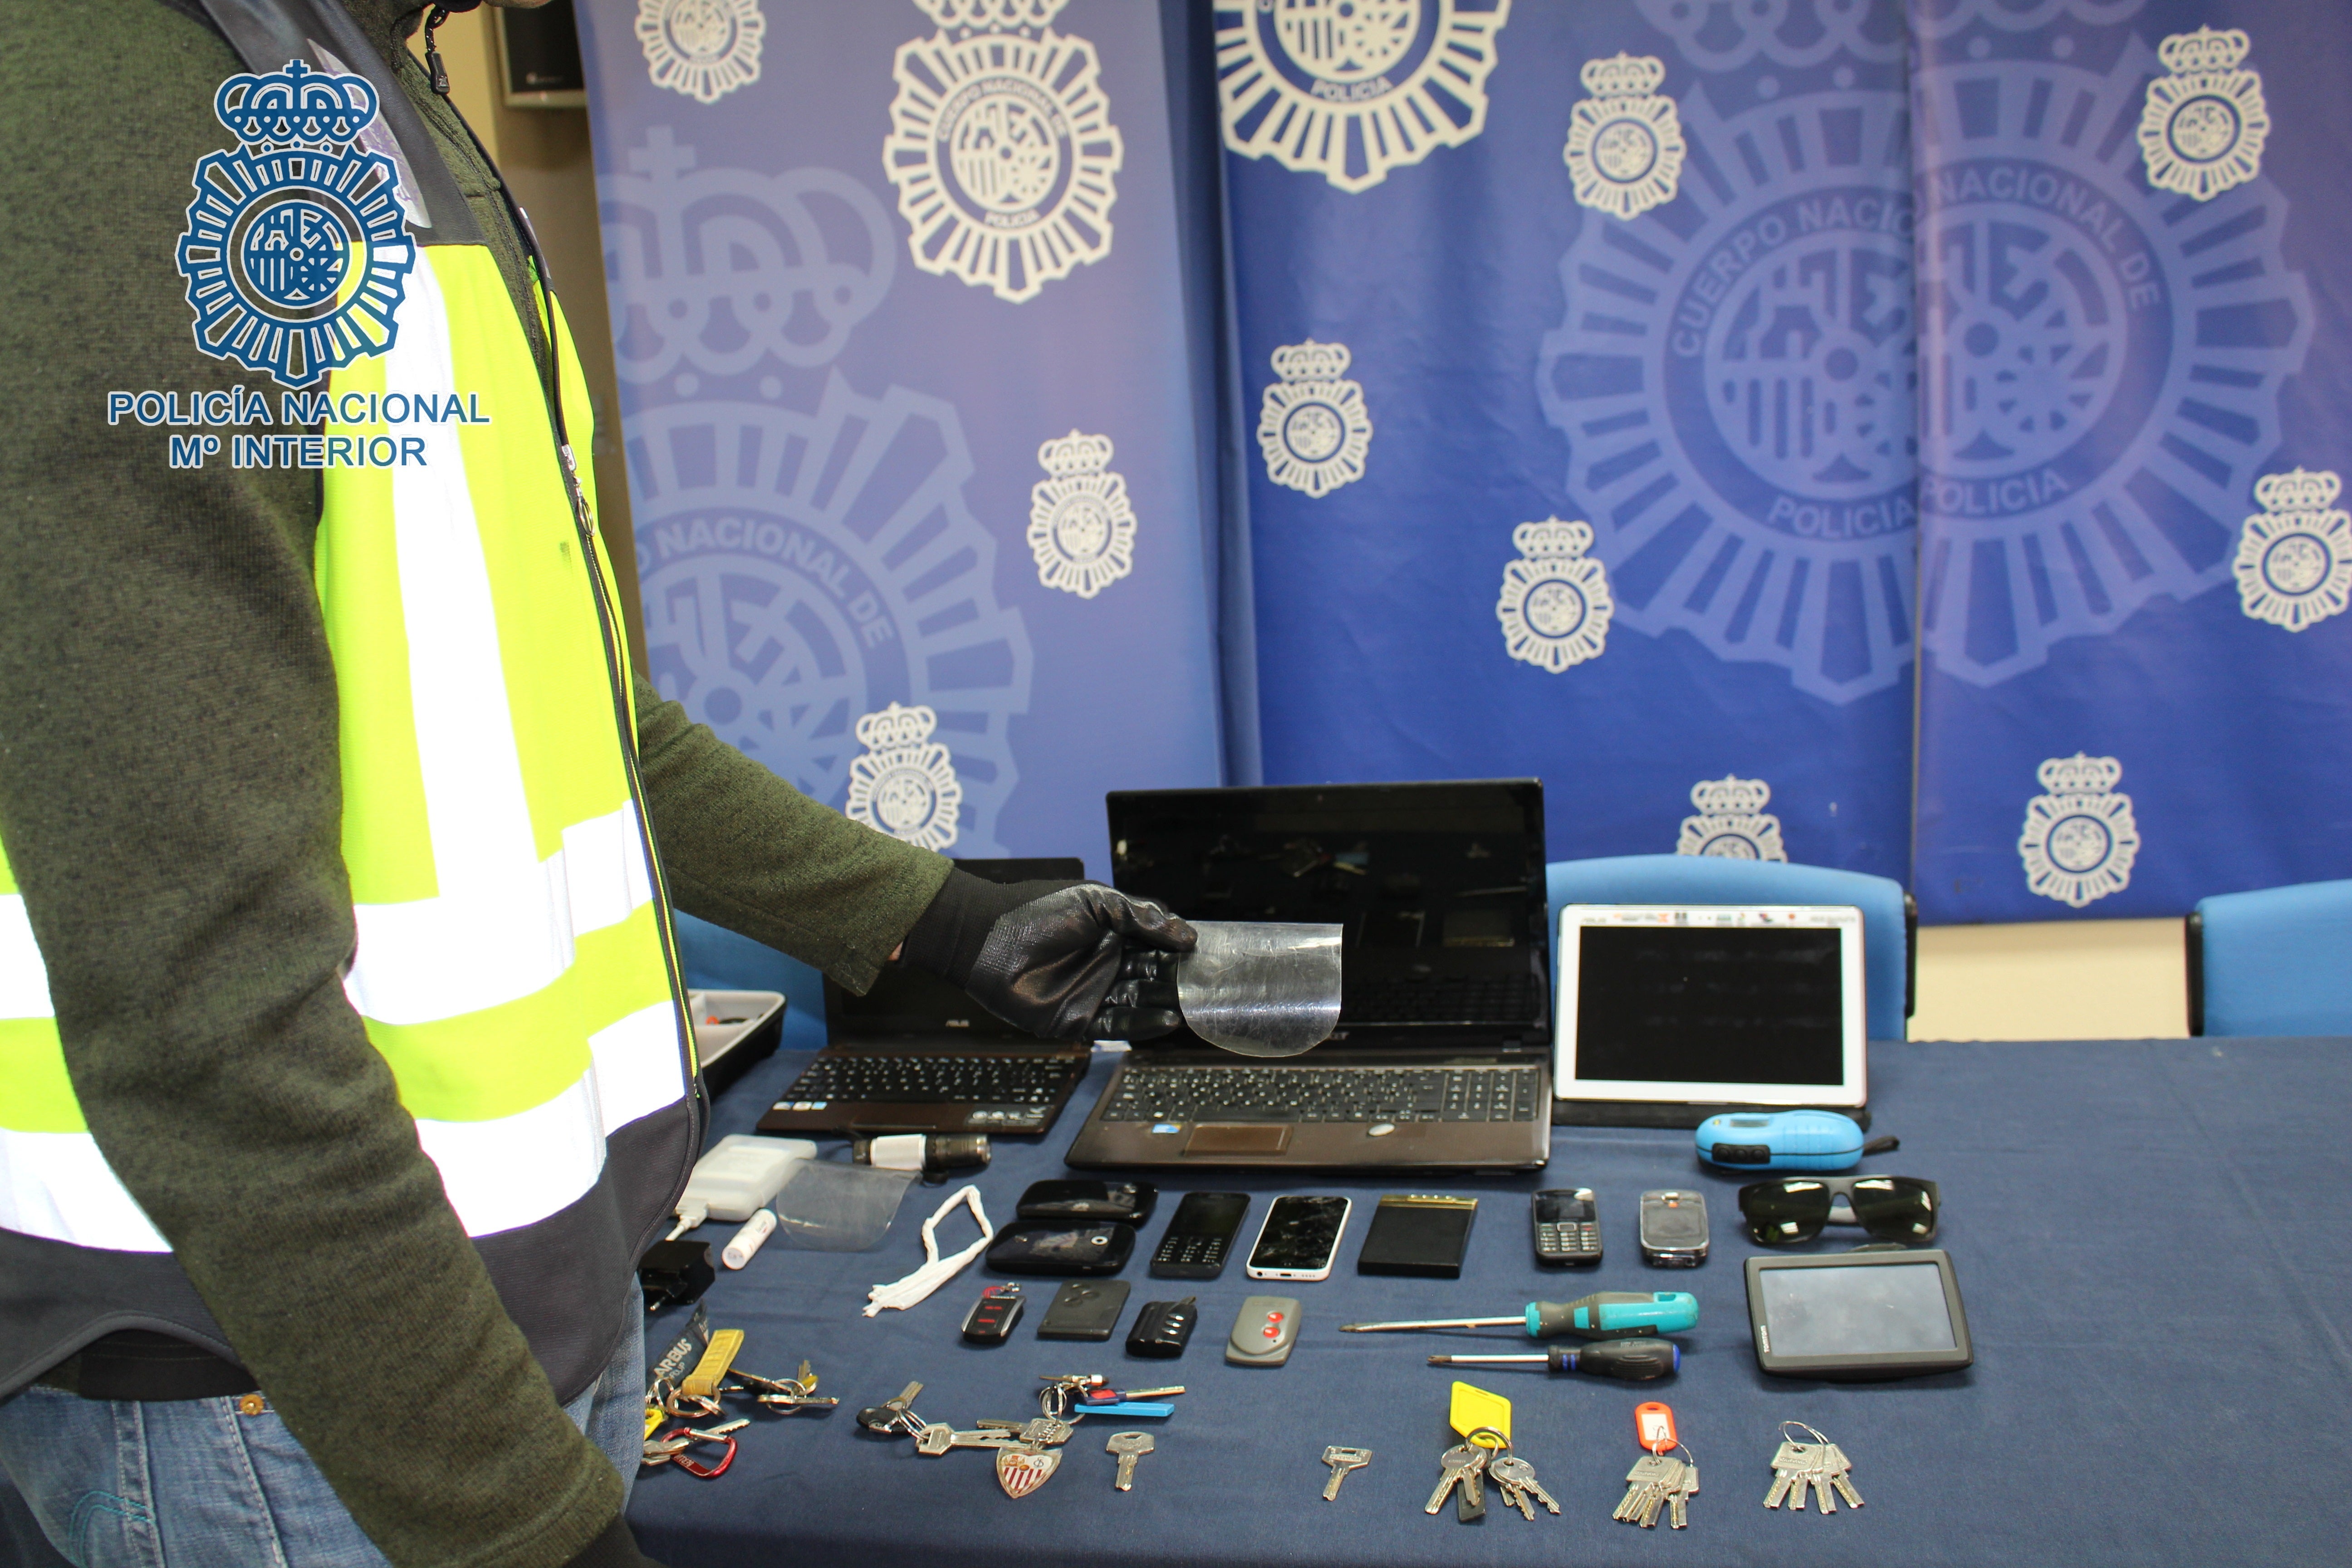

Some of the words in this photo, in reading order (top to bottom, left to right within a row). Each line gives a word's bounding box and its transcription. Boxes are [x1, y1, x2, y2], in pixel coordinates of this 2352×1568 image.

[1310, 75, 1394, 102] POLICIA
[1672, 214, 1787, 357] CUERPO
[2120, 250, 2161, 309] DE
[655, 516, 851, 600] NACIONAL
[848, 590, 896, 650] DE
